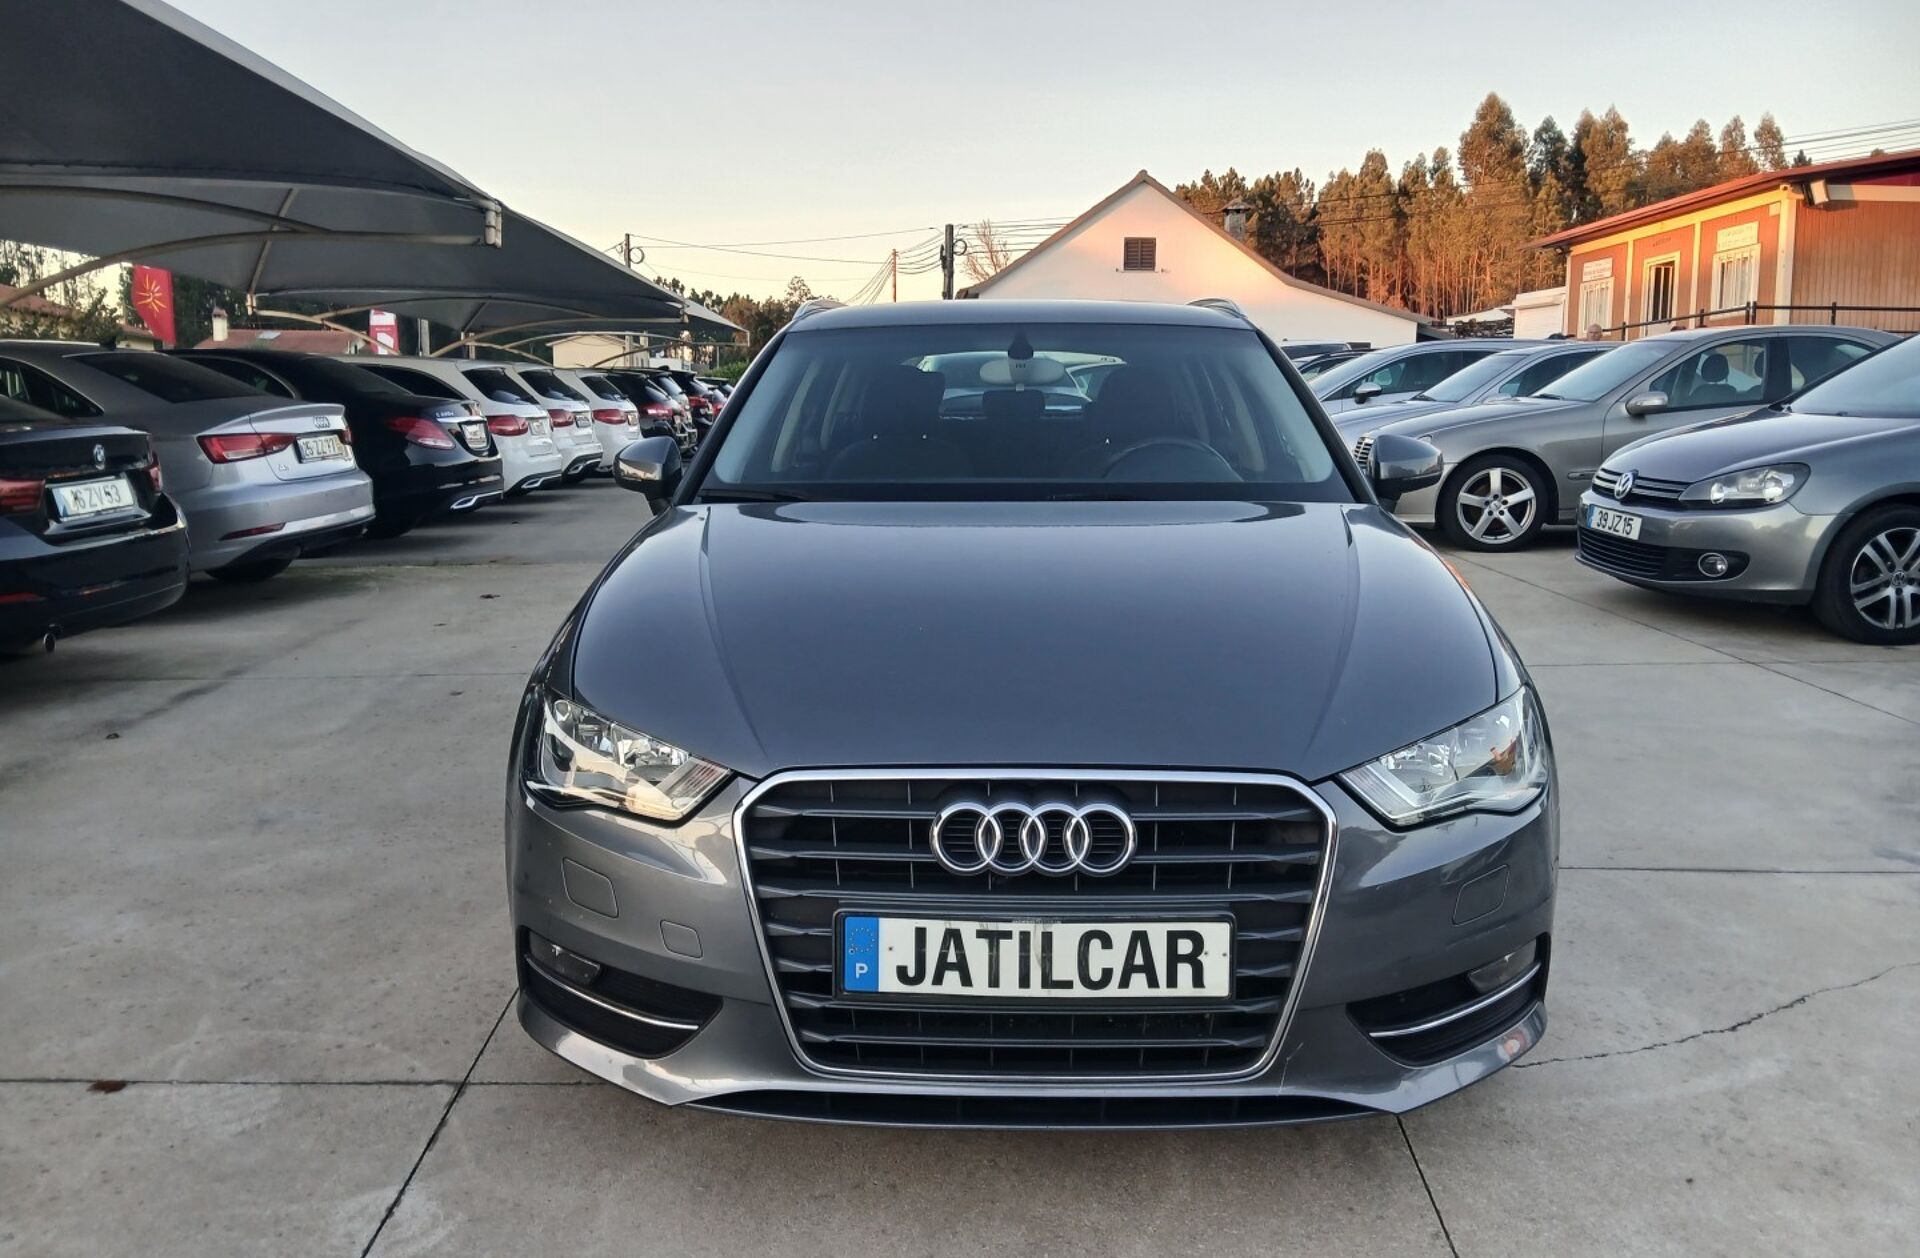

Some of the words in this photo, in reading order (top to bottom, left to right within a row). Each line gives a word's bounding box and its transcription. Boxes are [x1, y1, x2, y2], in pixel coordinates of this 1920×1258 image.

[1597, 510, 1634, 535] 39JZ15
[855, 962, 868, 979] P
[896, 926, 1206, 990] JATILCAR
